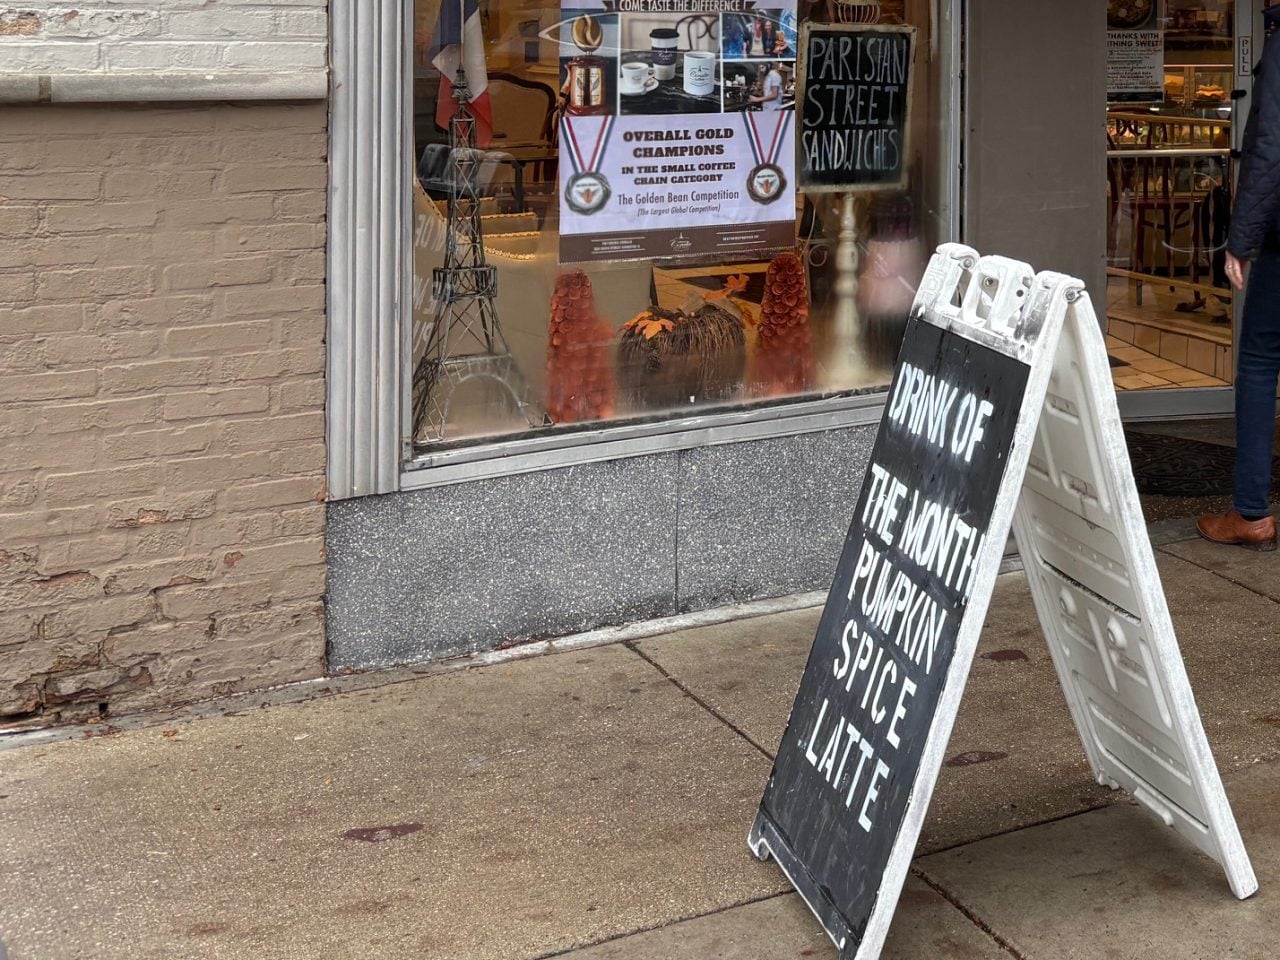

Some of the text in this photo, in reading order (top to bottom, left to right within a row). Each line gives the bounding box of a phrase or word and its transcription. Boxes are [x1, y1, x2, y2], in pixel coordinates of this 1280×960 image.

[619, 0, 741, 11] COME TASTE THE DIFFERENCE
[808, 37, 907, 84] PARISIAN
[803, 84, 899, 127] STREET
[623, 128, 734, 142] OVERALL GOLD
[633, 144, 724, 158] CHAMPIONS
[801, 128, 899, 171] SANDWICHES
[622, 162, 736, 174] IN THE SMALL COFFEE
[634, 174, 723, 185] CHAIN CATEGORY
[618, 190, 739, 205] The Golden Bean Competition
[888, 361, 994, 463] DRINK OF
[861, 462, 986, 597] THE MONTH
[848, 538, 948, 675] PUMPKIN
[833, 619, 917, 749] SPICE
[805, 698, 890, 833] LATTE
